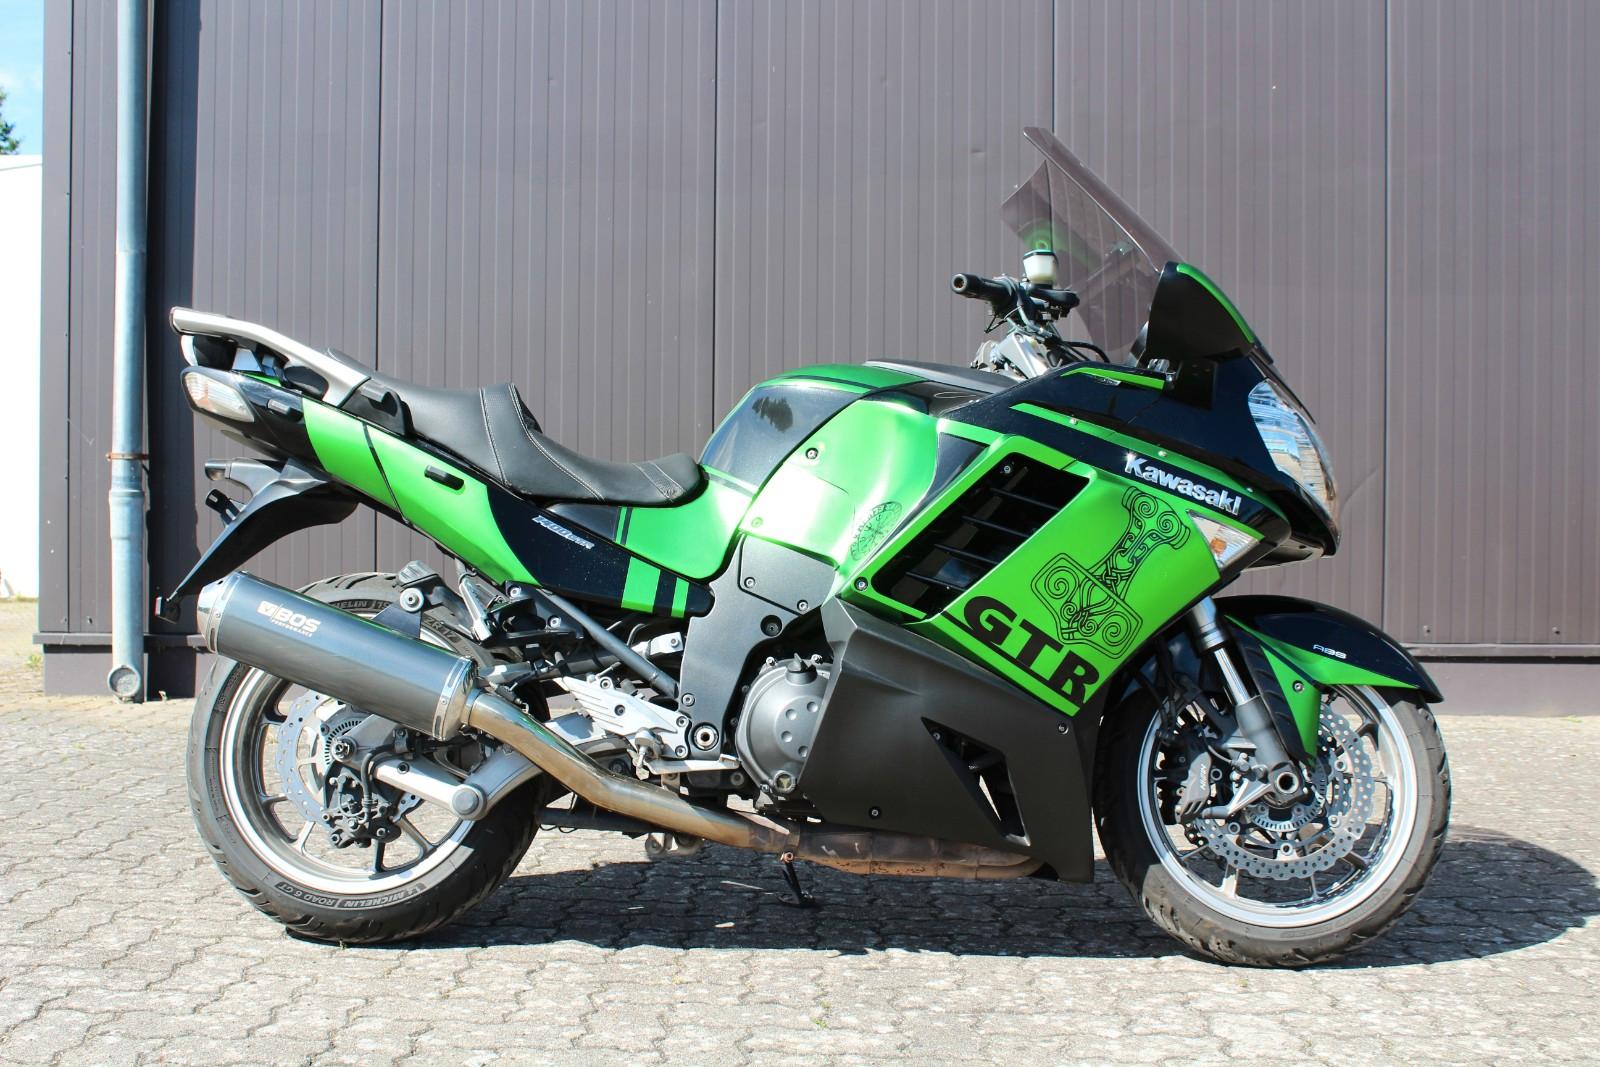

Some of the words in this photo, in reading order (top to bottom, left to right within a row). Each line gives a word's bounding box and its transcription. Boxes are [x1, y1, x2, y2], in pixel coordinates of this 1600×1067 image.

[1124, 455, 1242, 515] Kawasaki
[273, 606, 322, 633] BOS
[963, 595, 1100, 713] GTR
[1312, 643, 1347, 660] ABS
[277, 882, 295, 895] GT
[294, 889, 302, 898] 6
[302, 894, 335, 907] ROAD
[344, 890, 405, 908] MICHELIN
